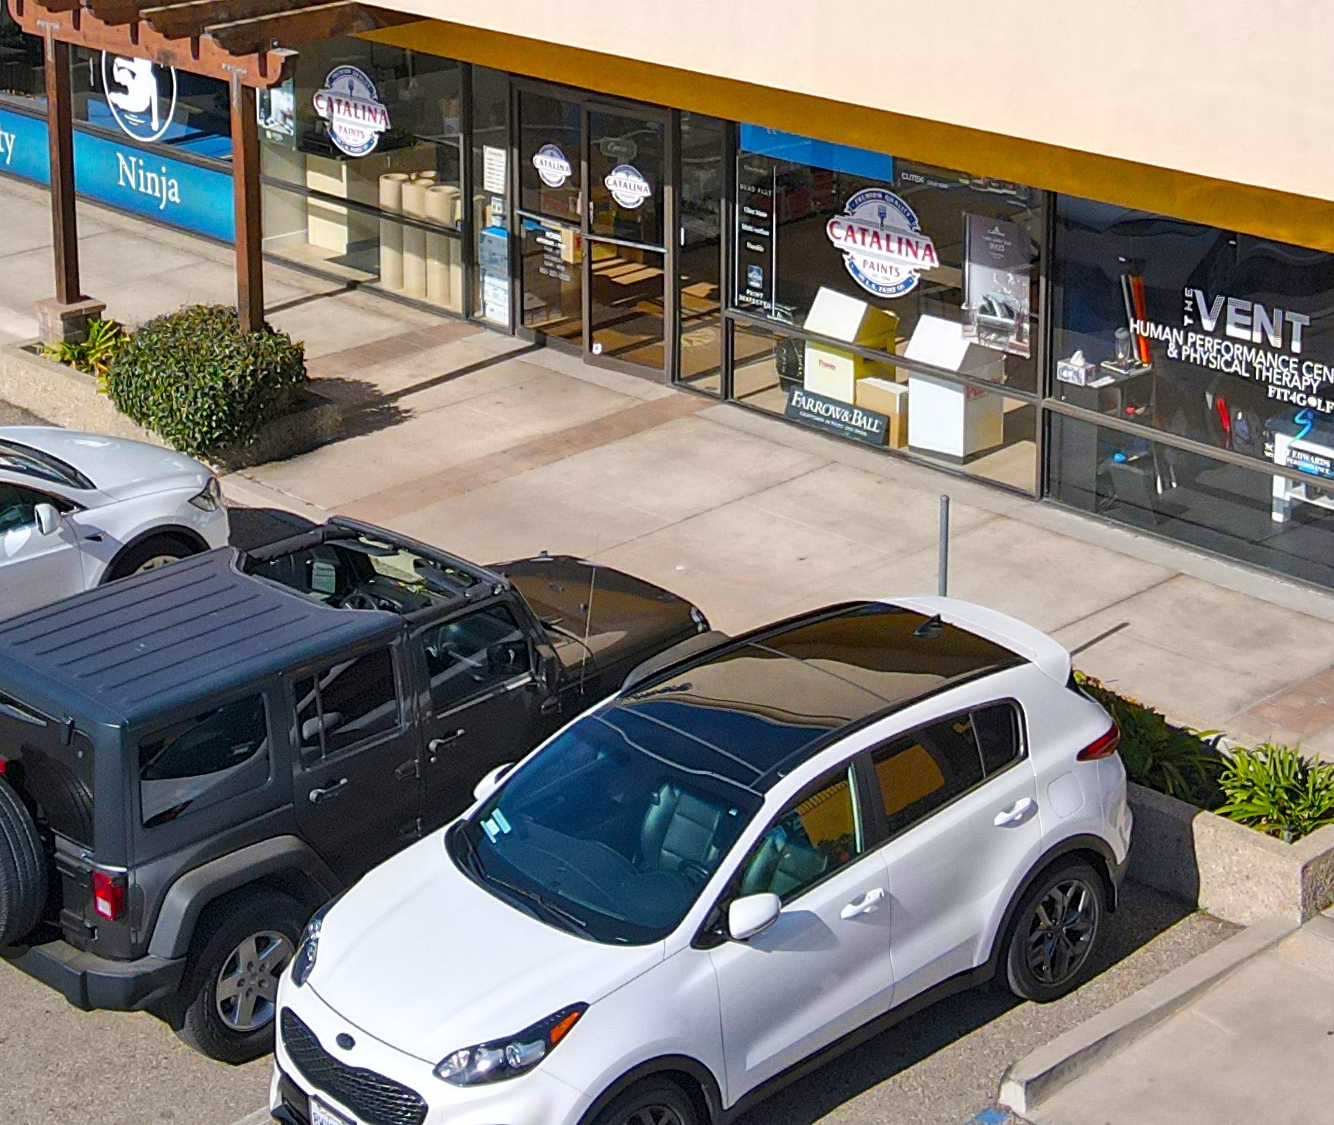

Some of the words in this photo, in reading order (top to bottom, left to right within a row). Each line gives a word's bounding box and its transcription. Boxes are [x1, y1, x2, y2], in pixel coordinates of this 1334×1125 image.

[315, 93, 389, 126] CATALINA
[338, 125, 365, 139] PAINTS
[117, 152, 181, 210] Ninja
[533, 155, 571, 174] CATALINA
[606, 177, 650, 194] CATALINA
[829, 220, 936, 264] CATALINA
[863, 260, 901, 277] PAINTS
[1183, 287, 1195, 327] THE
[1193, 289, 1310, 354] VENT
[1129, 318, 1184, 345] HUMAN
[1187, 331, 1298, 373] PERFORMANCE
[1167, 343, 1179, 359] &
[1181, 347, 1250, 378] PHYSICAL
[1254, 364, 1321, 394] THERAPY
[791, 390, 844, 420] FARROW
[852, 408, 882, 434] BALL
[1292, 450, 1331, 468] EDWARDS
